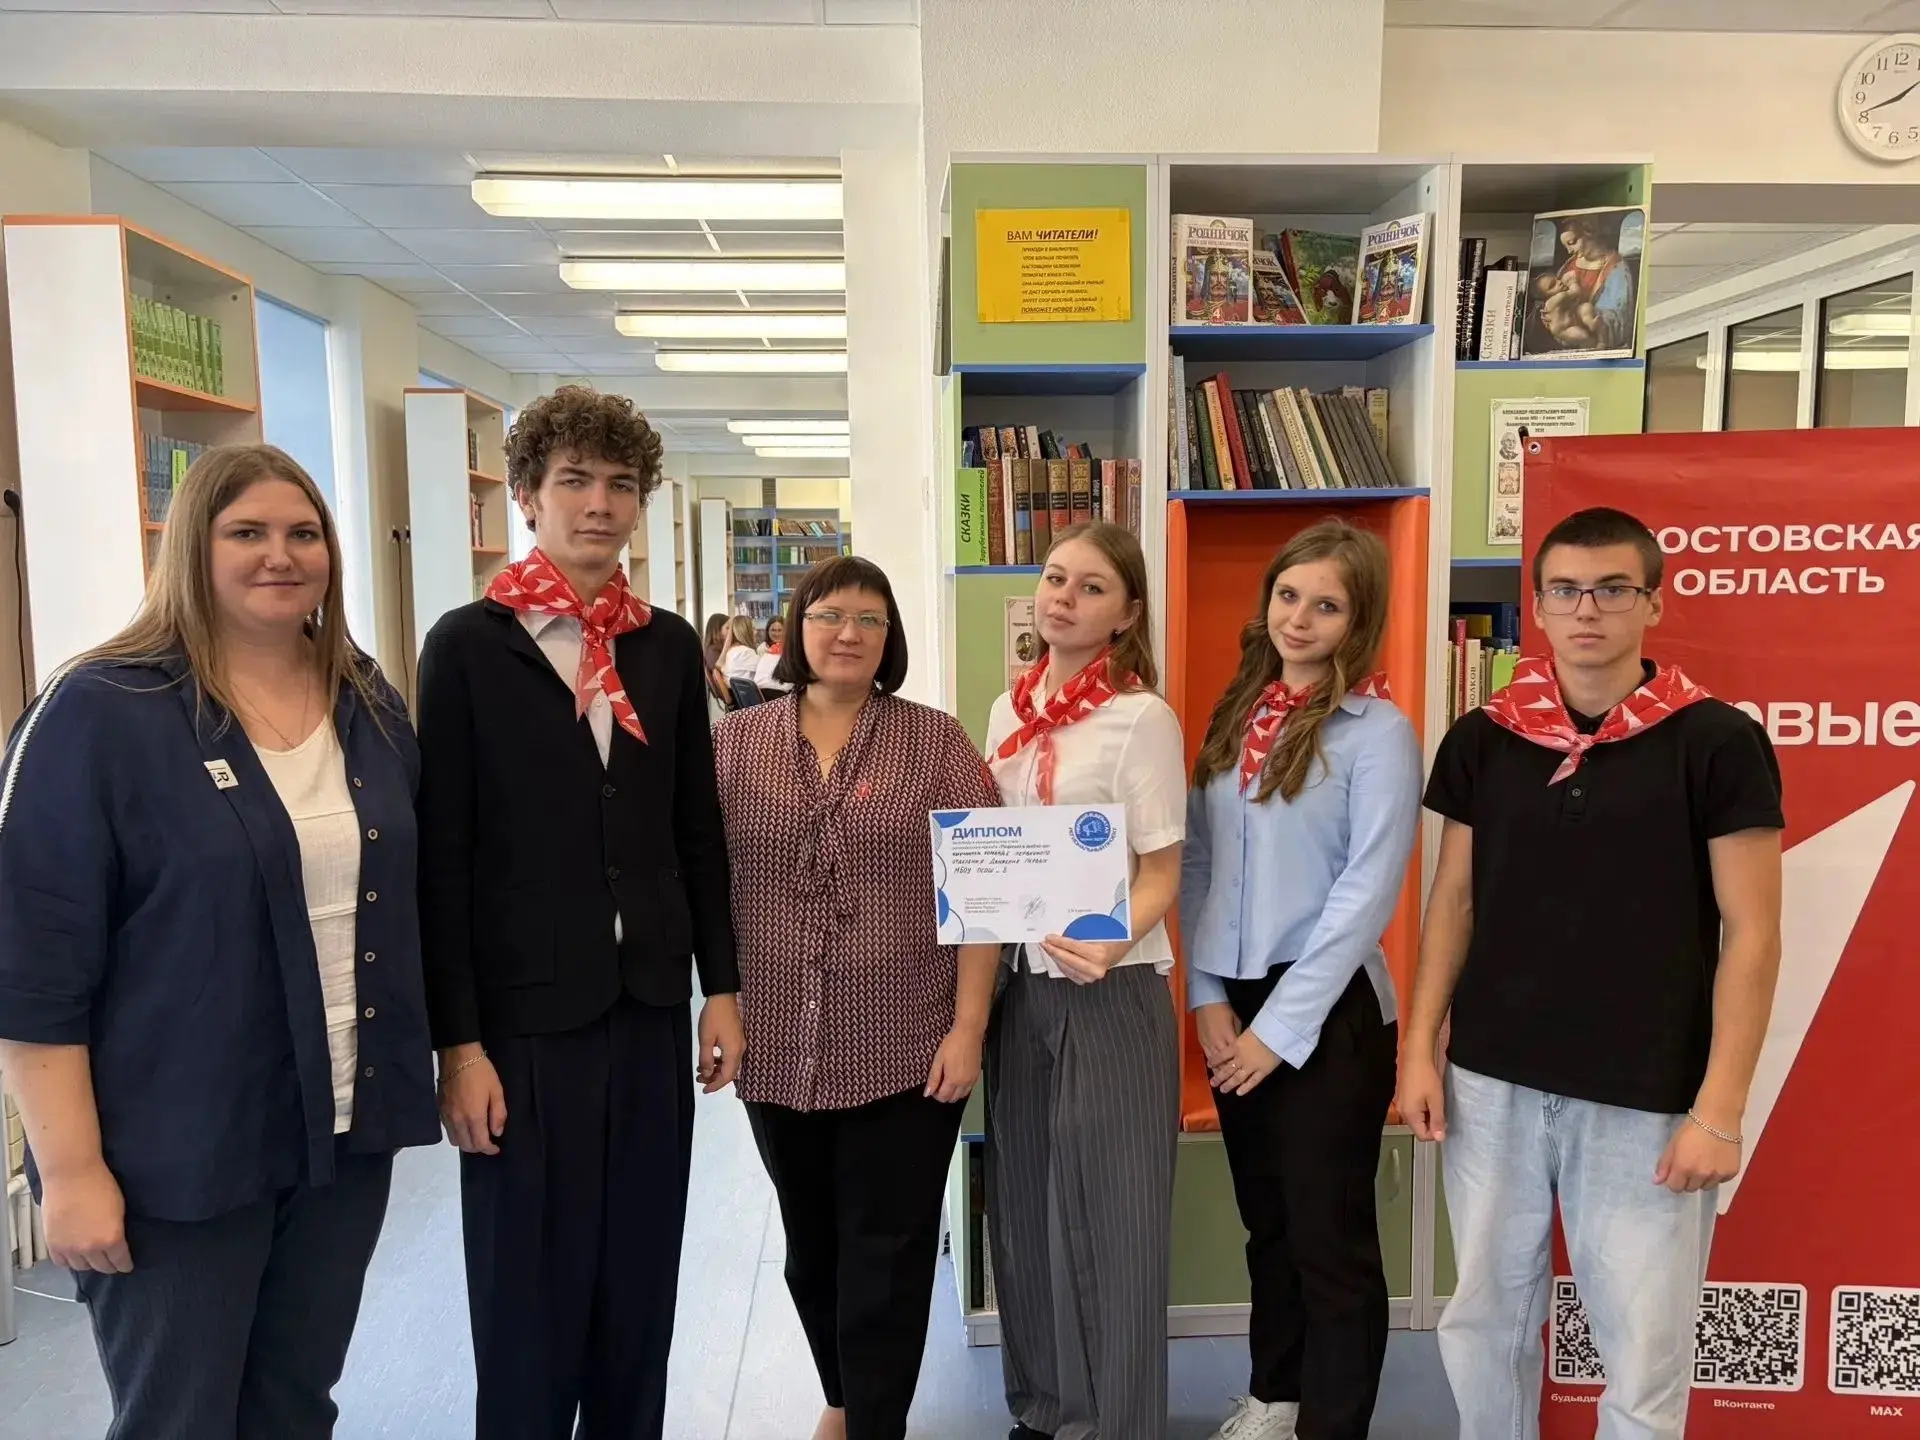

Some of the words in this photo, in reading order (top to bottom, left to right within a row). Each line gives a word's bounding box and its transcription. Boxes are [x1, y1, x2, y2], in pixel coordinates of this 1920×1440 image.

[1877, 56, 1888, 71] 11
[1894, 52, 1909, 66] 12
[1860, 72, 1875, 85] 10
[1855, 91, 1866, 105] 9
[1859, 111, 1869, 124] 8
[1873, 126, 1882, 139] 7
[1888, 131, 1899, 144] 6
[1908, 126, 1919, 140] 5
[1007, 231, 1033, 240] ВАМ
[1036, 229, 1098, 240] ЧИТАТЕЛИ!
[1188, 225, 1249, 242] РОДНИЧОК
[1367, 223, 1420, 247] РОДНИЧОК
[1481, 309, 1497, 359] Сказки
[960, 493, 971, 543] СКАЗКИ
[1648, 522, 1920, 555] ОСТОВСКАЯ
[1673, 567, 1885, 596] ОБЛАСТЬ
[1469, 666, 1477, 707] ВОЛКОВ
[952, 826, 1022, 841] ДИПЛОМ
[1713, 1399, 1775, 1410] ВКонтакте
[1870, 1405, 1904, 1417] MAX
